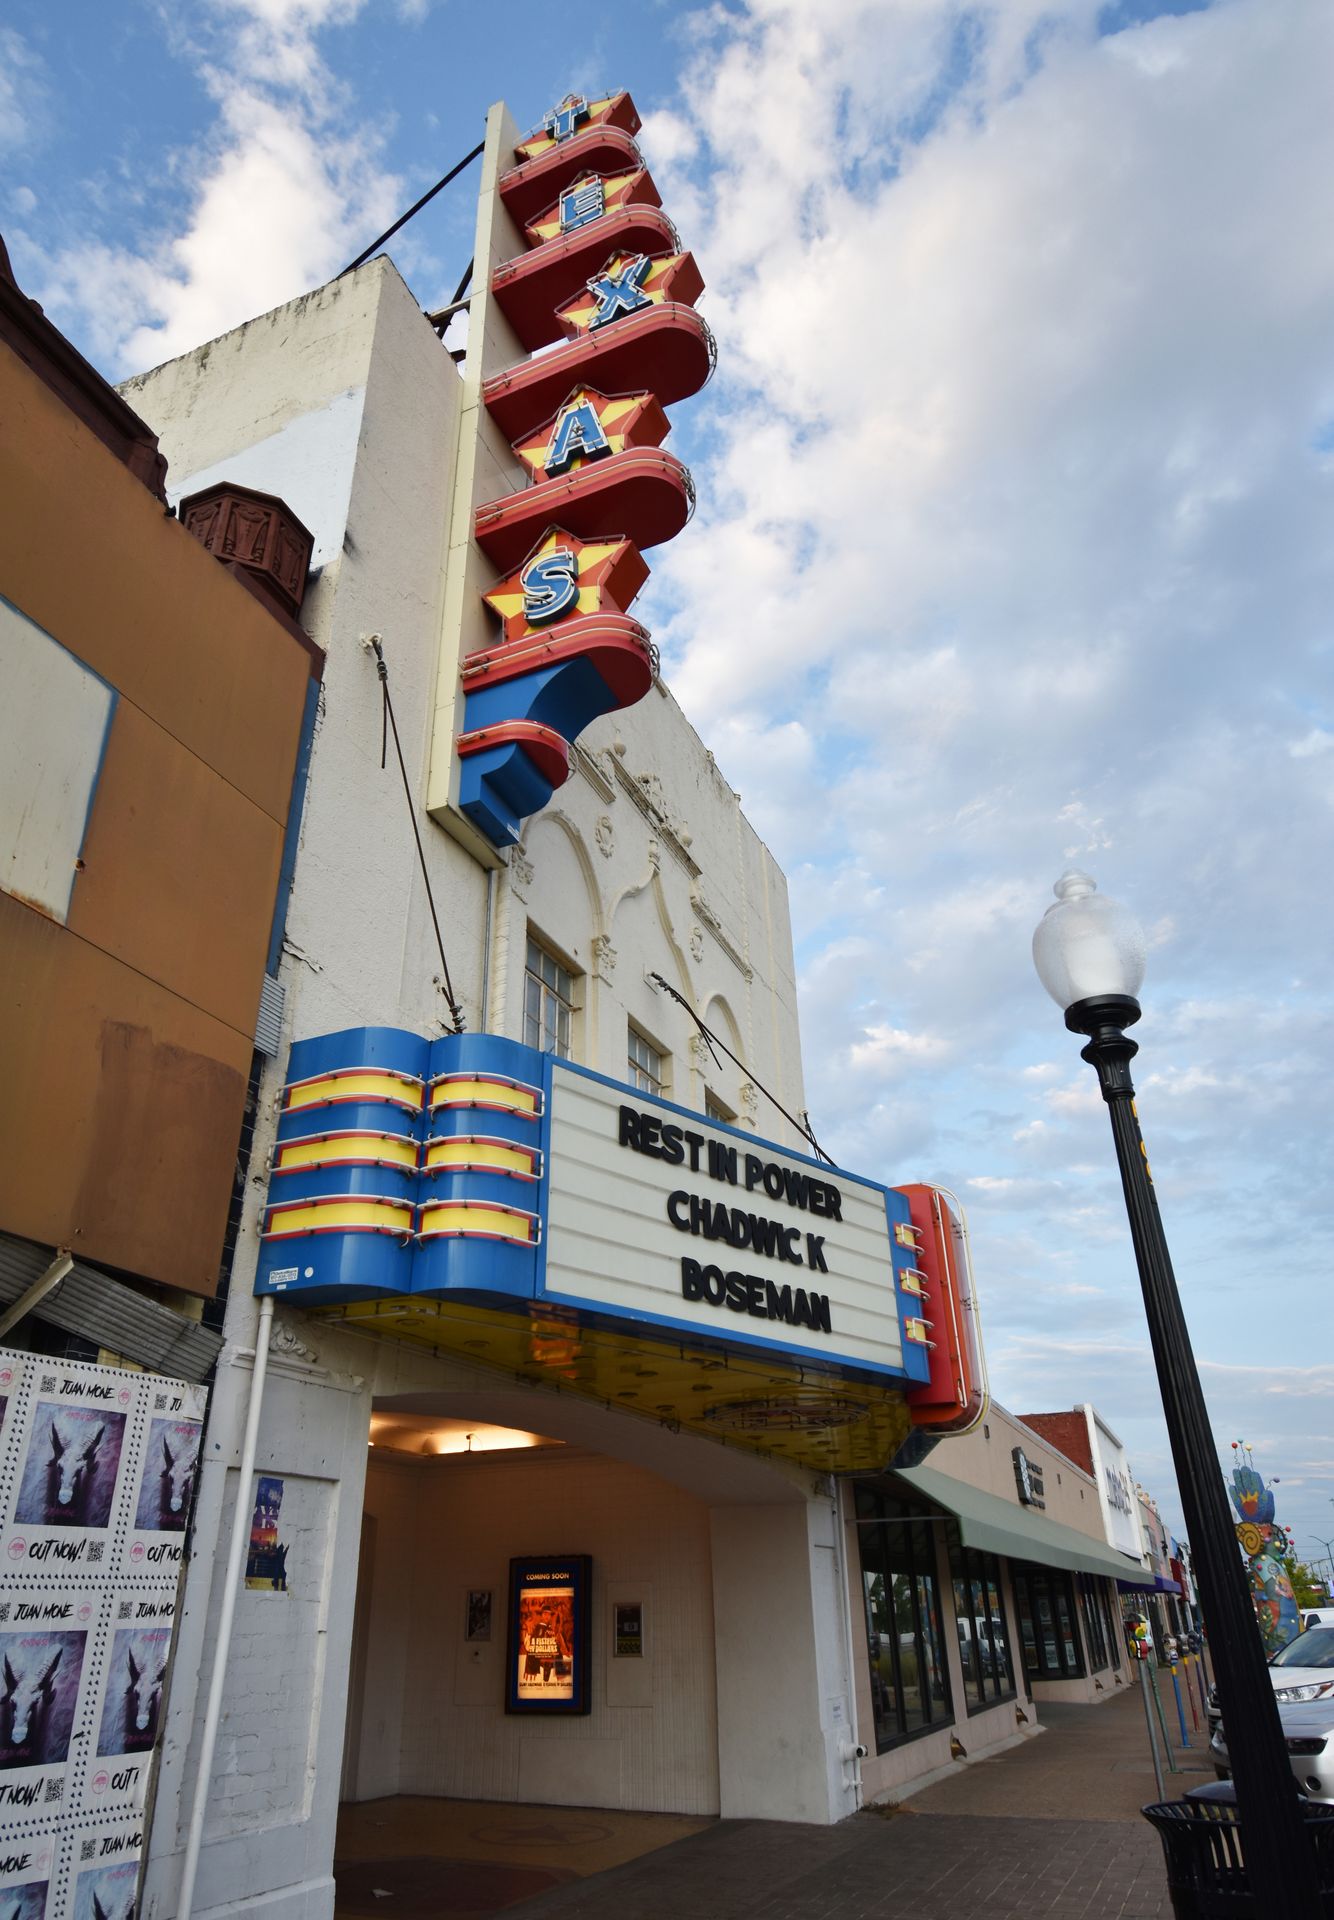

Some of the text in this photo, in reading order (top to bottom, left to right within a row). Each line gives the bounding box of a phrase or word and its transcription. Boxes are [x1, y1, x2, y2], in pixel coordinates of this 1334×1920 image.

[521, 93, 655, 627] TEXAS
[619, 1105, 843, 1222] REST IN POWER
[681, 1257, 832, 1334] BOSEMAN
[60, 1379, 86, 1395] JUAN
[29, 1538, 87, 1563] OUT NOW!
[147, 1544, 171, 1563] OUT
[526, 1572, 569, 1581] COMING SOON
[13, 1602, 43, 1621] JUAN
[136, 1603, 159, 1618] JUAN
[6, 1777, 44, 1807] NOW!
[100, 1833, 126, 1857] JUAN
